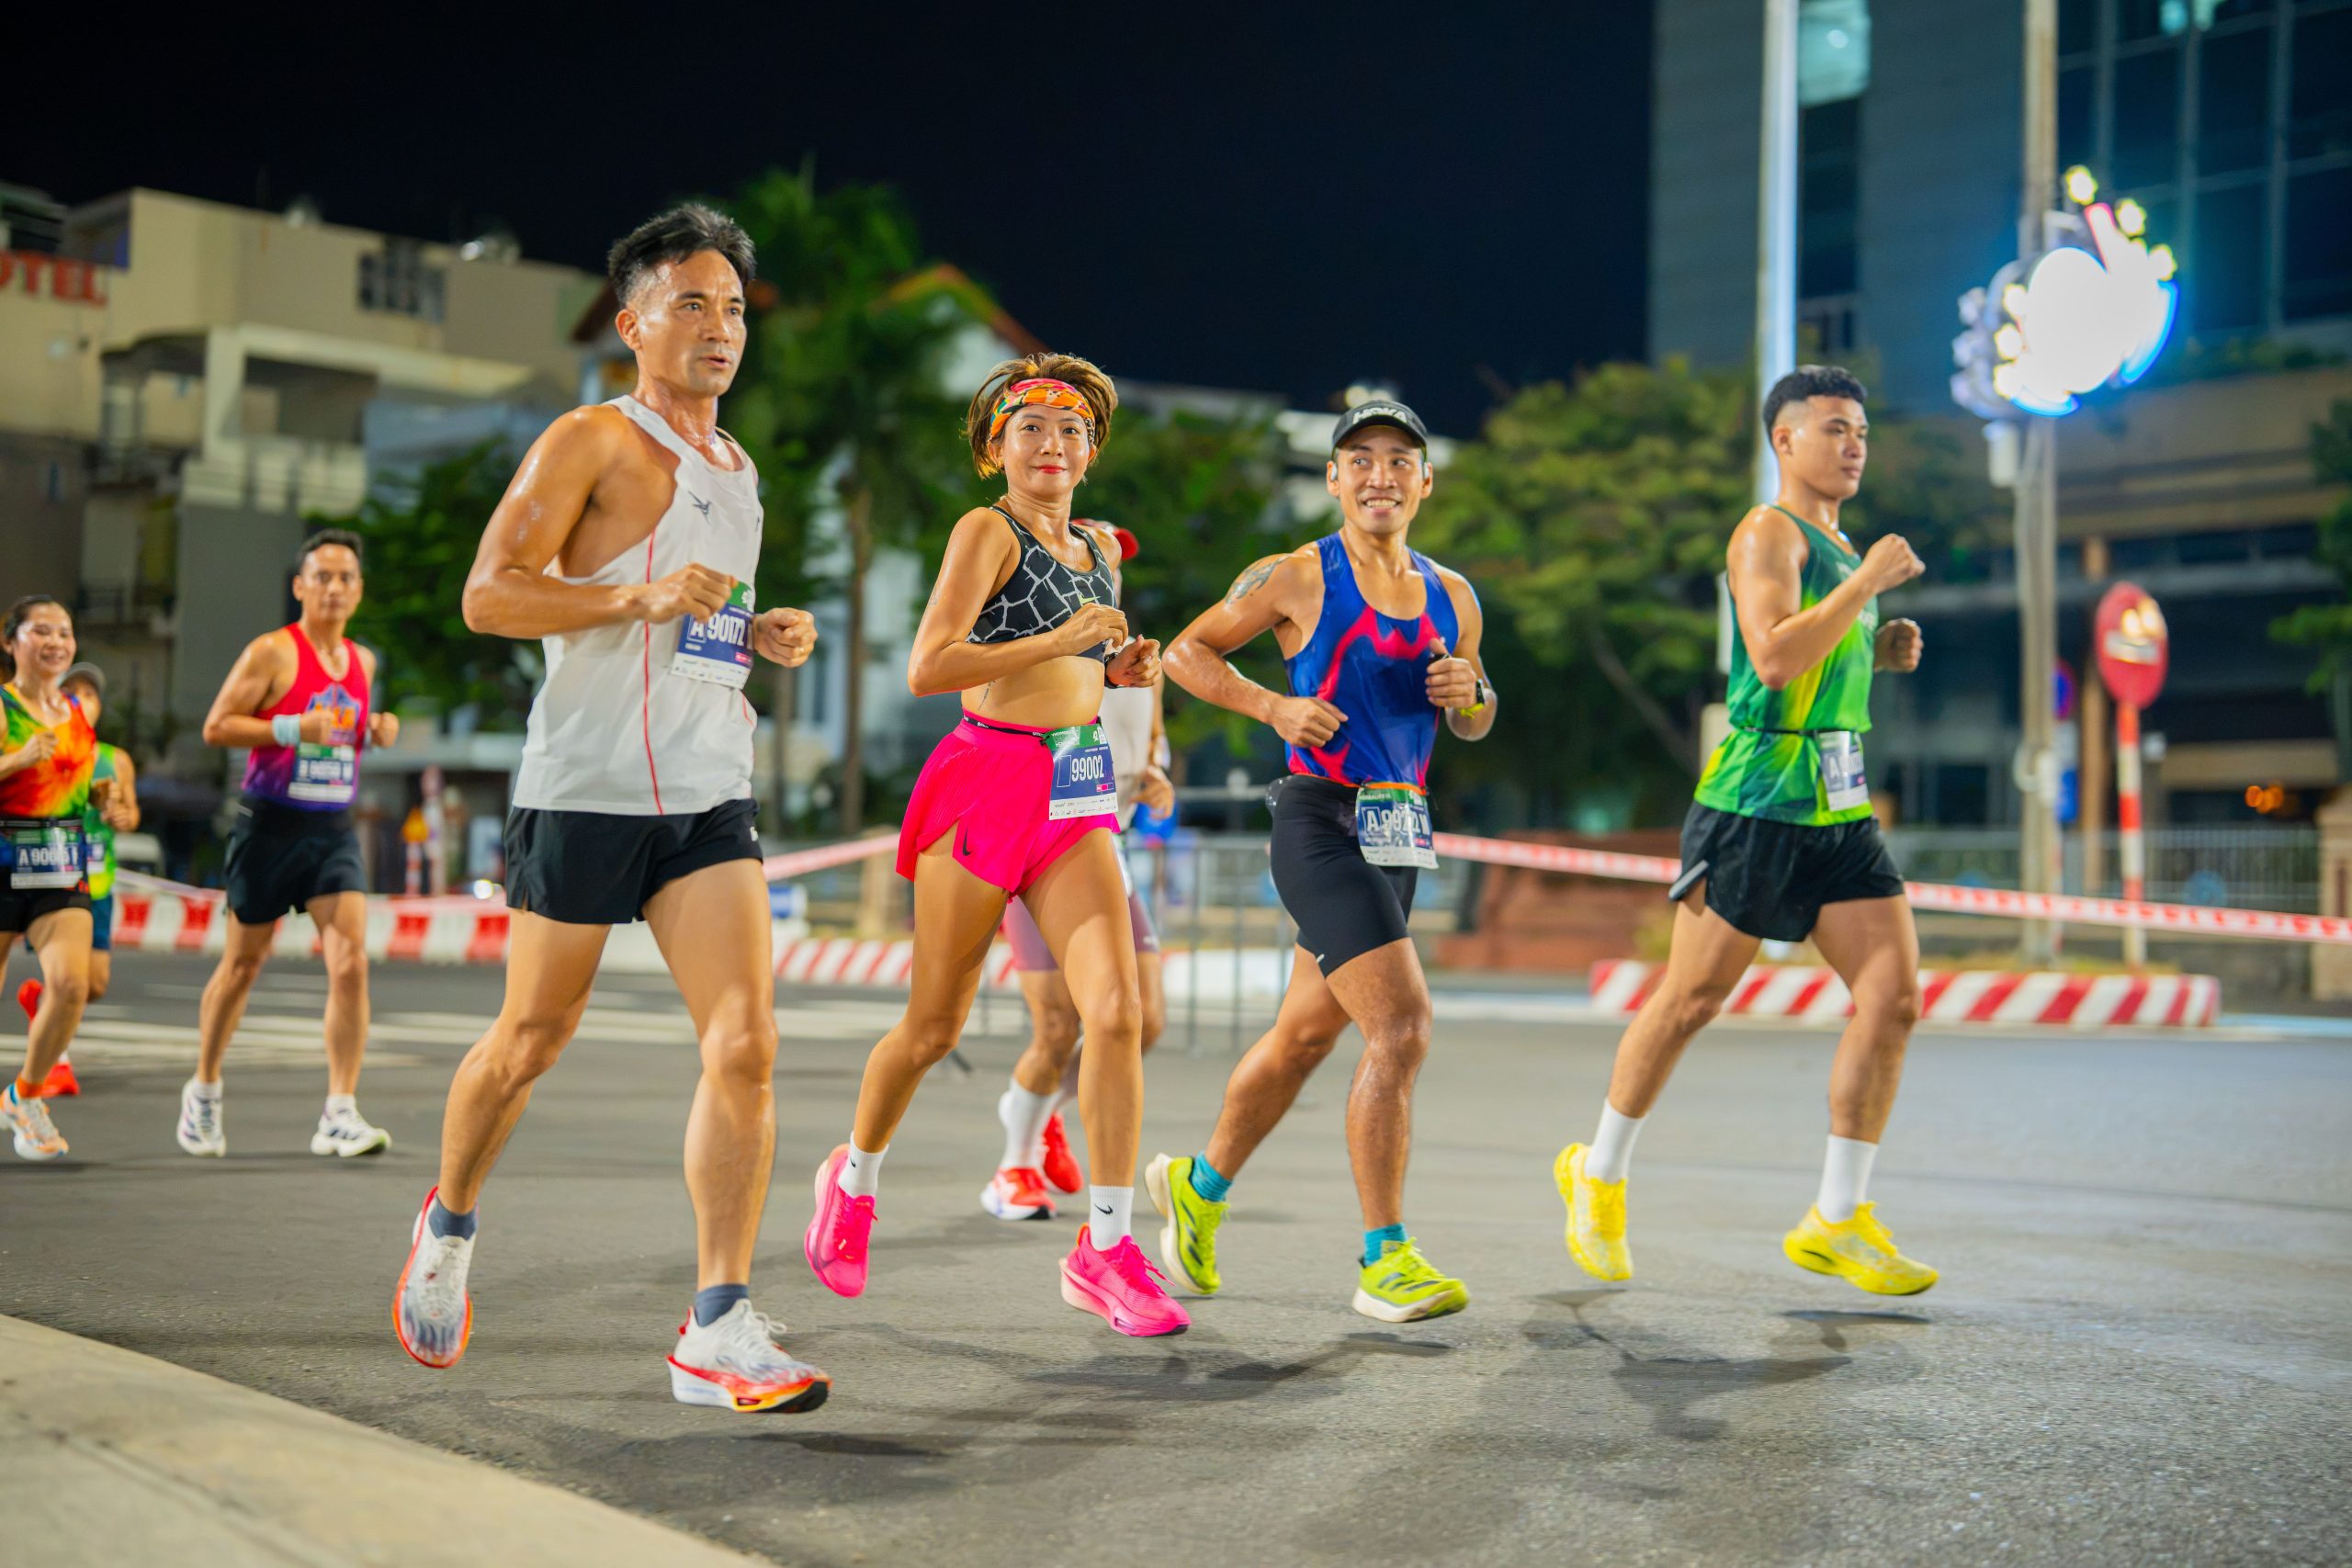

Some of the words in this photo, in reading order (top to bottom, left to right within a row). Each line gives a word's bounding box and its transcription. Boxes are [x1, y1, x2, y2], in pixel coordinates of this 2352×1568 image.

[1352, 407, 1407, 424] HOKA
[1071, 754, 1105, 782] 99002
[1366, 810, 1379, 831] A
[19, 848, 29, 866] A
